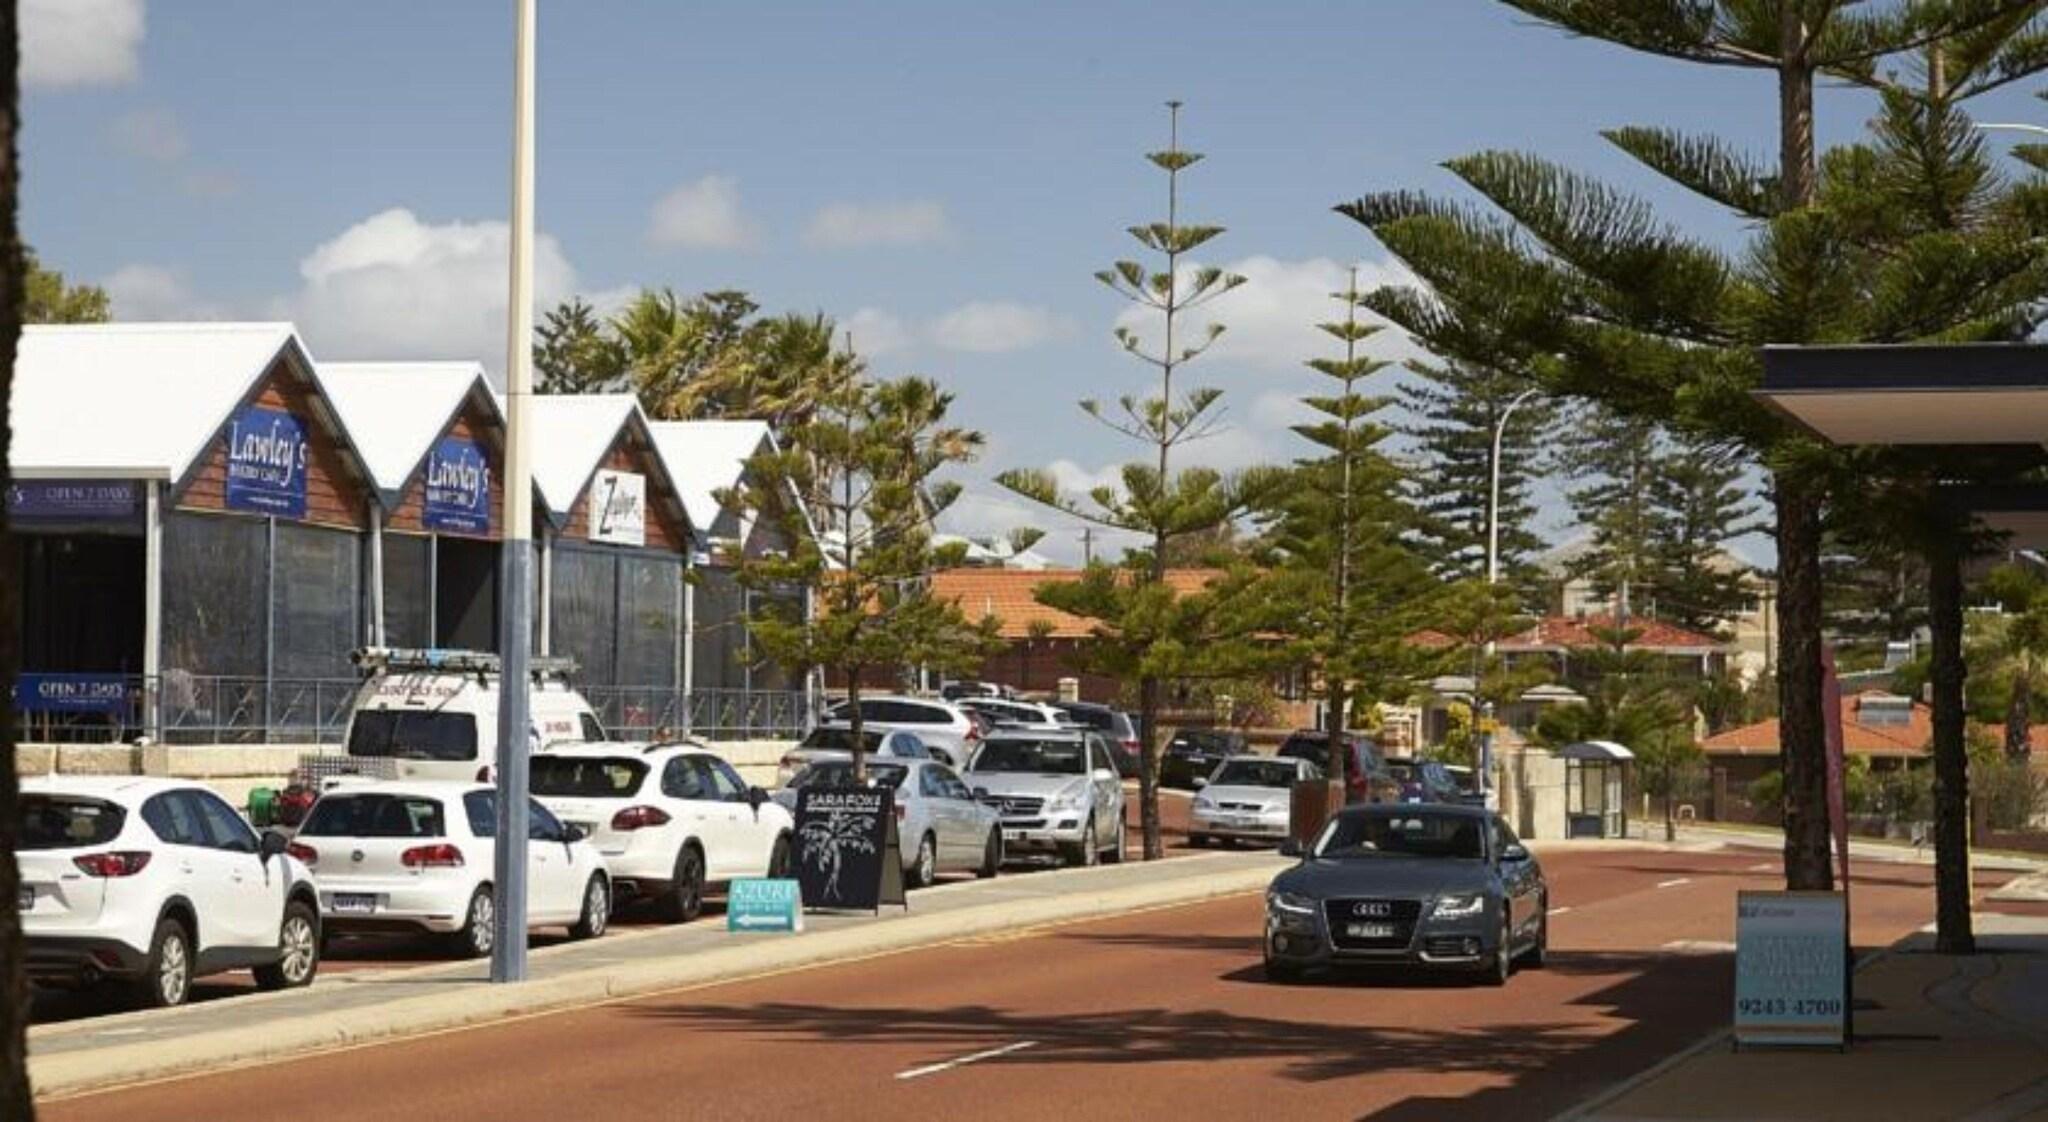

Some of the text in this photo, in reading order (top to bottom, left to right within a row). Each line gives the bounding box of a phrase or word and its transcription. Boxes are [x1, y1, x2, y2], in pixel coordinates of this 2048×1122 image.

[230, 419, 306, 487] Lawley's
[428, 448, 490, 509] Lawley's
[46, 487, 84, 499] OPEN
[87, 487, 95, 499] 7
[38, 681, 123, 698] OPEN 7 DAYS
[1793, 998, 1841, 1015] 4700
